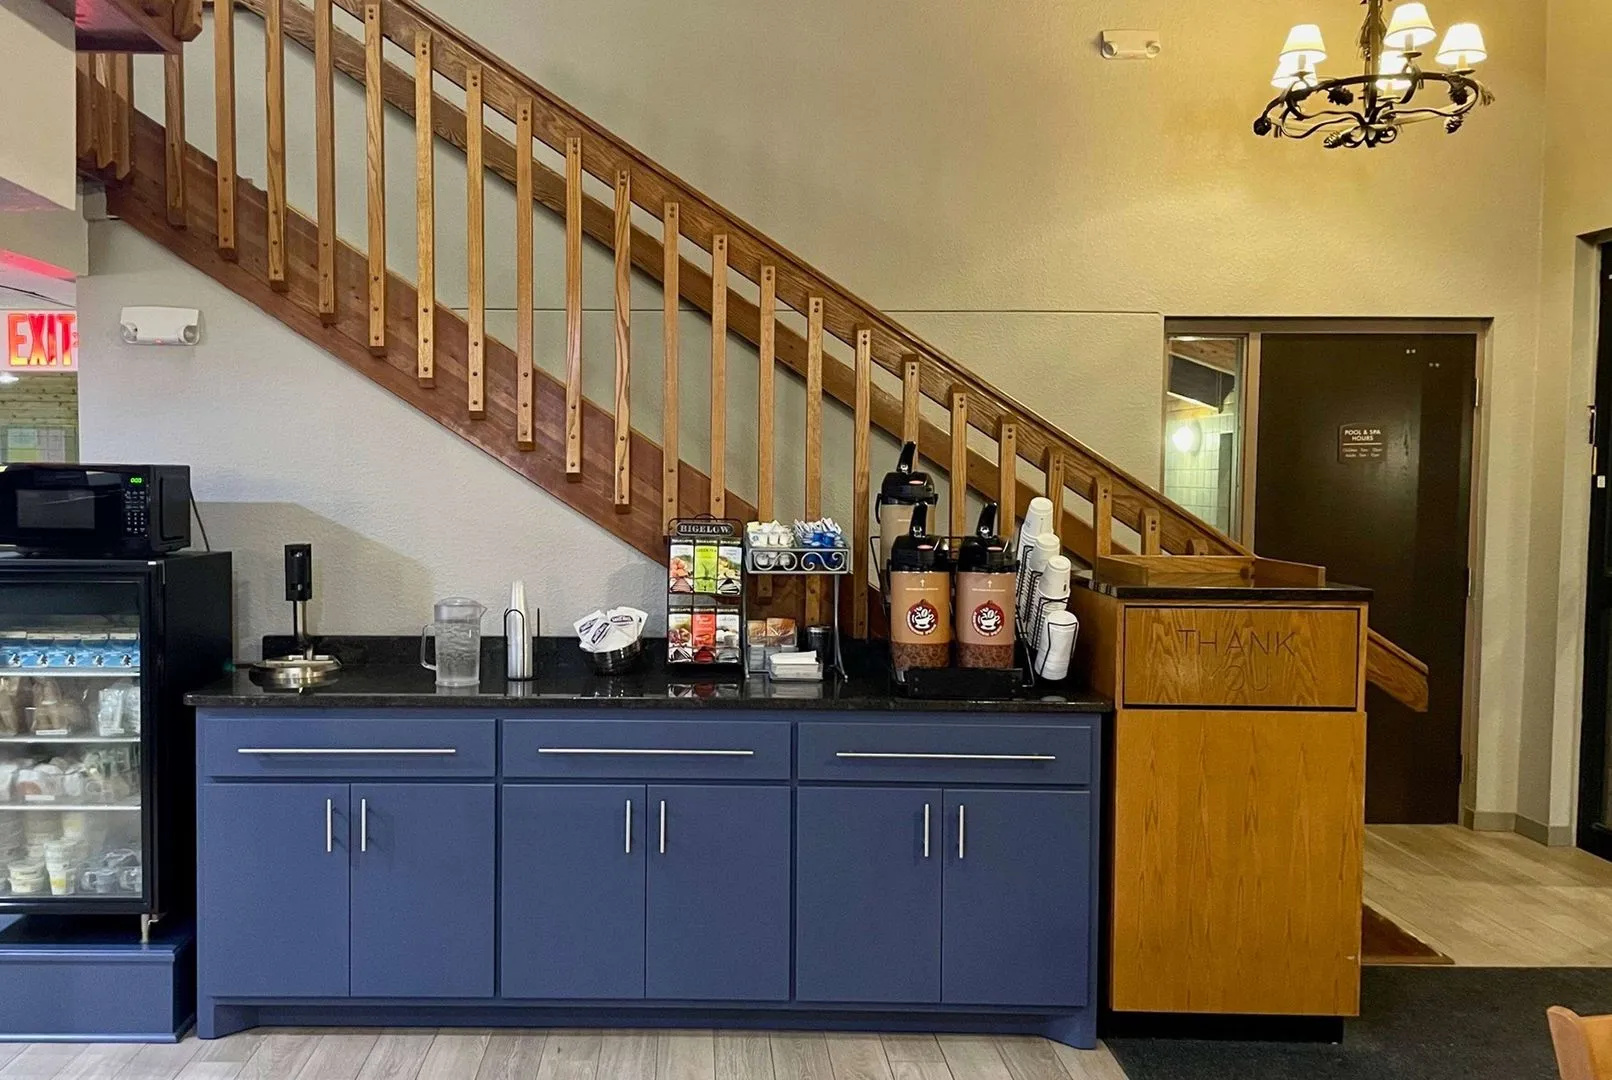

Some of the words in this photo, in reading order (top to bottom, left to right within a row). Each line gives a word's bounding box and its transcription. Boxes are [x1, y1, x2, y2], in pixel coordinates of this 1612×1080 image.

[8, 313, 76, 366] EXIT
[680, 524, 730, 533] BIGELOW
[1177, 629, 1296, 657] THANK
[1201, 663, 1270, 692] YOU
